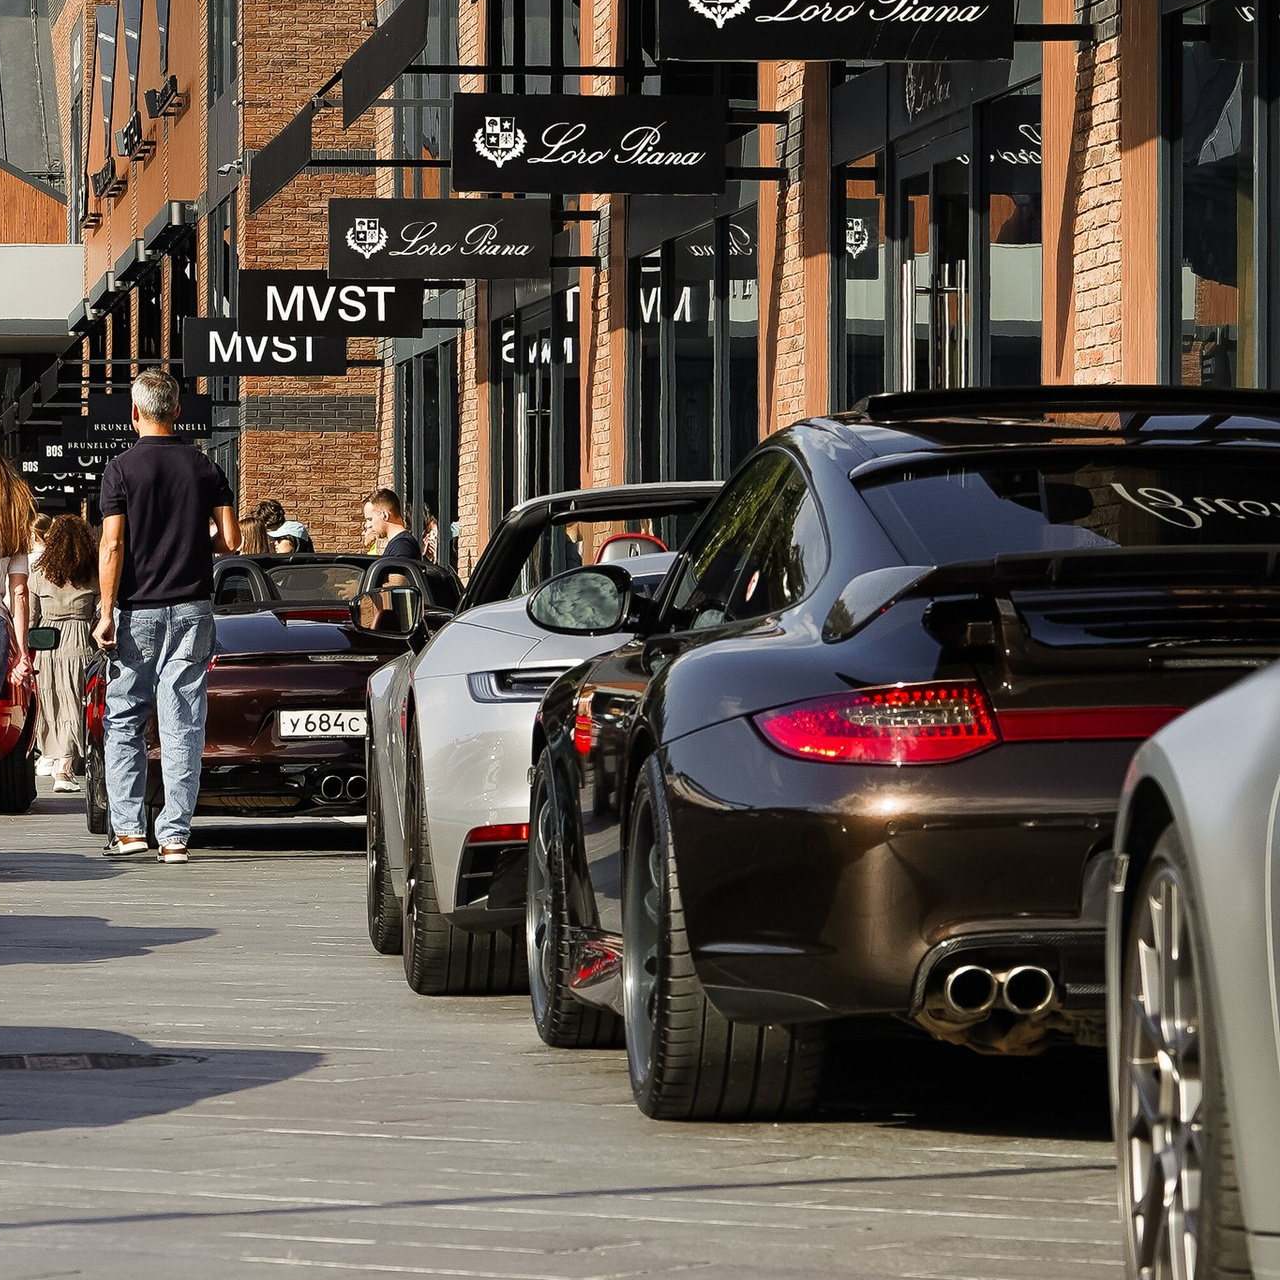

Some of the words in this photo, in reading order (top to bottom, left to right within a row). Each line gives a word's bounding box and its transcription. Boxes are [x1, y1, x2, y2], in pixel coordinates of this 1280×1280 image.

[527, 122, 611, 164] Loro
[614, 121, 706, 165] Piana
[389, 221, 457, 256] Loro
[460, 218, 535, 256] Piana
[266, 285, 396, 322] MVST
[94, 423, 133, 431] BRUNEL
[174, 423, 207, 431] INELLI
[46, 445, 63, 458] BOS
[68, 442, 117, 450] BRUNELLO
[22, 461, 39, 473] BOS
[290, 713, 367, 733] Y684C
